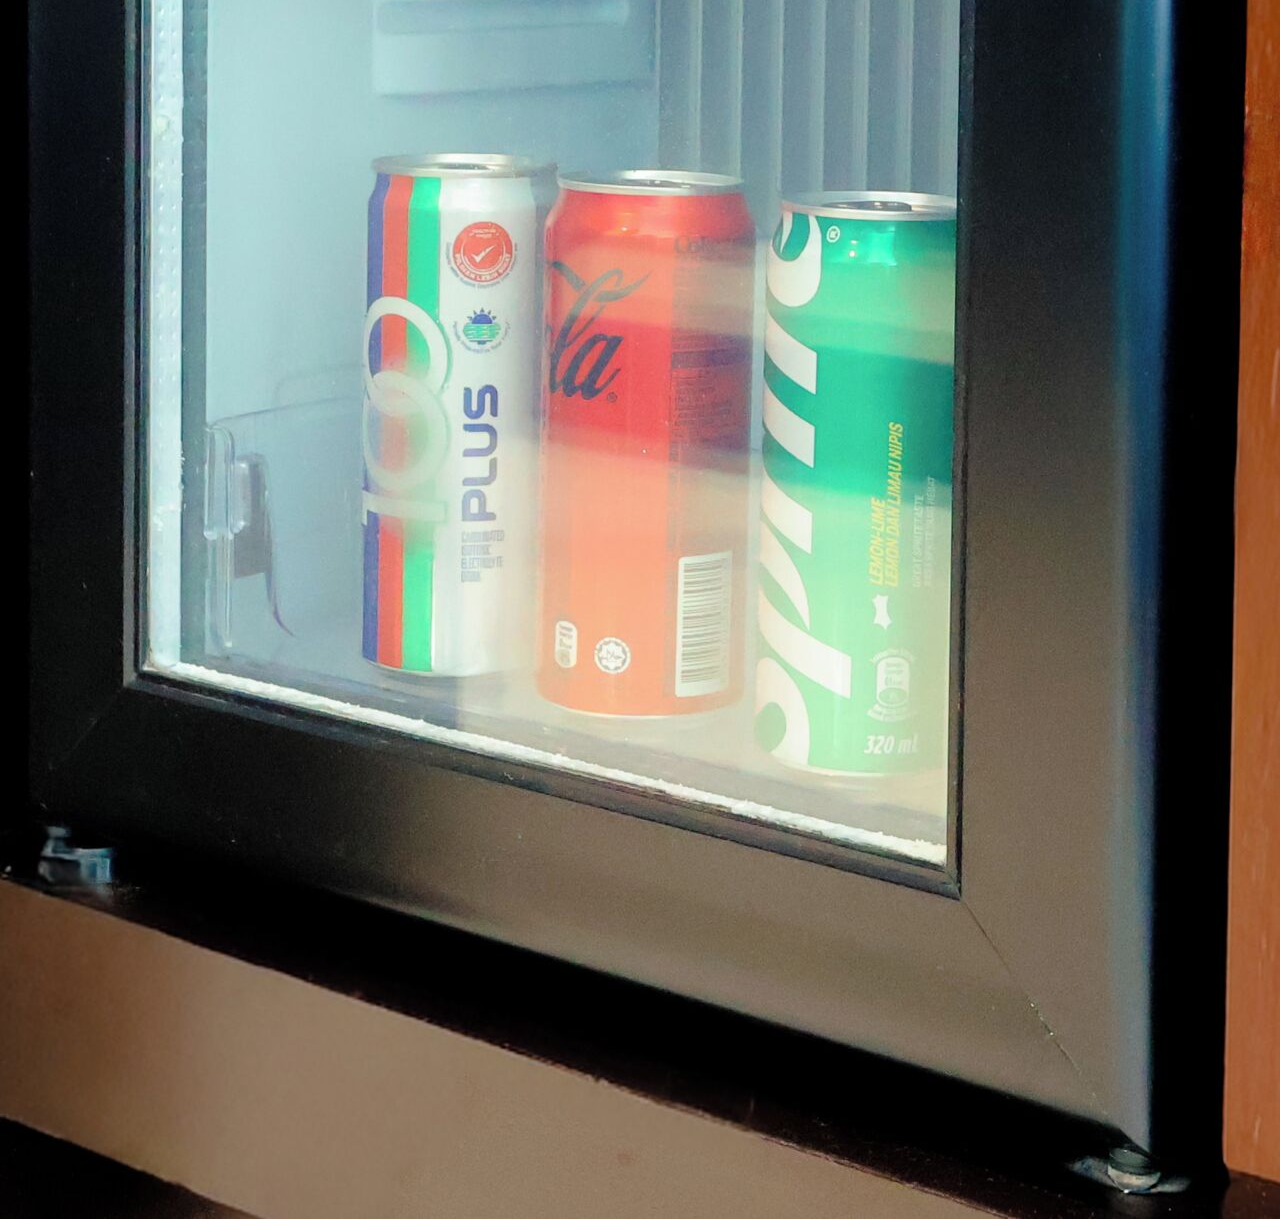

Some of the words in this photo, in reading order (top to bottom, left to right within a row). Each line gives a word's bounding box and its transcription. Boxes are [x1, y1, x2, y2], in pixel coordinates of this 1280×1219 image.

[460, 384, 499, 522] PLUS
[888, 421, 904, 460] NIPIS
[887, 460, 902, 505] LIMAU
[868, 497, 886, 586] LEMON-LIME
[885, 506, 901, 537] DAN
[884, 539, 900, 588] LEMON
[863, 734, 895, 754] 320
